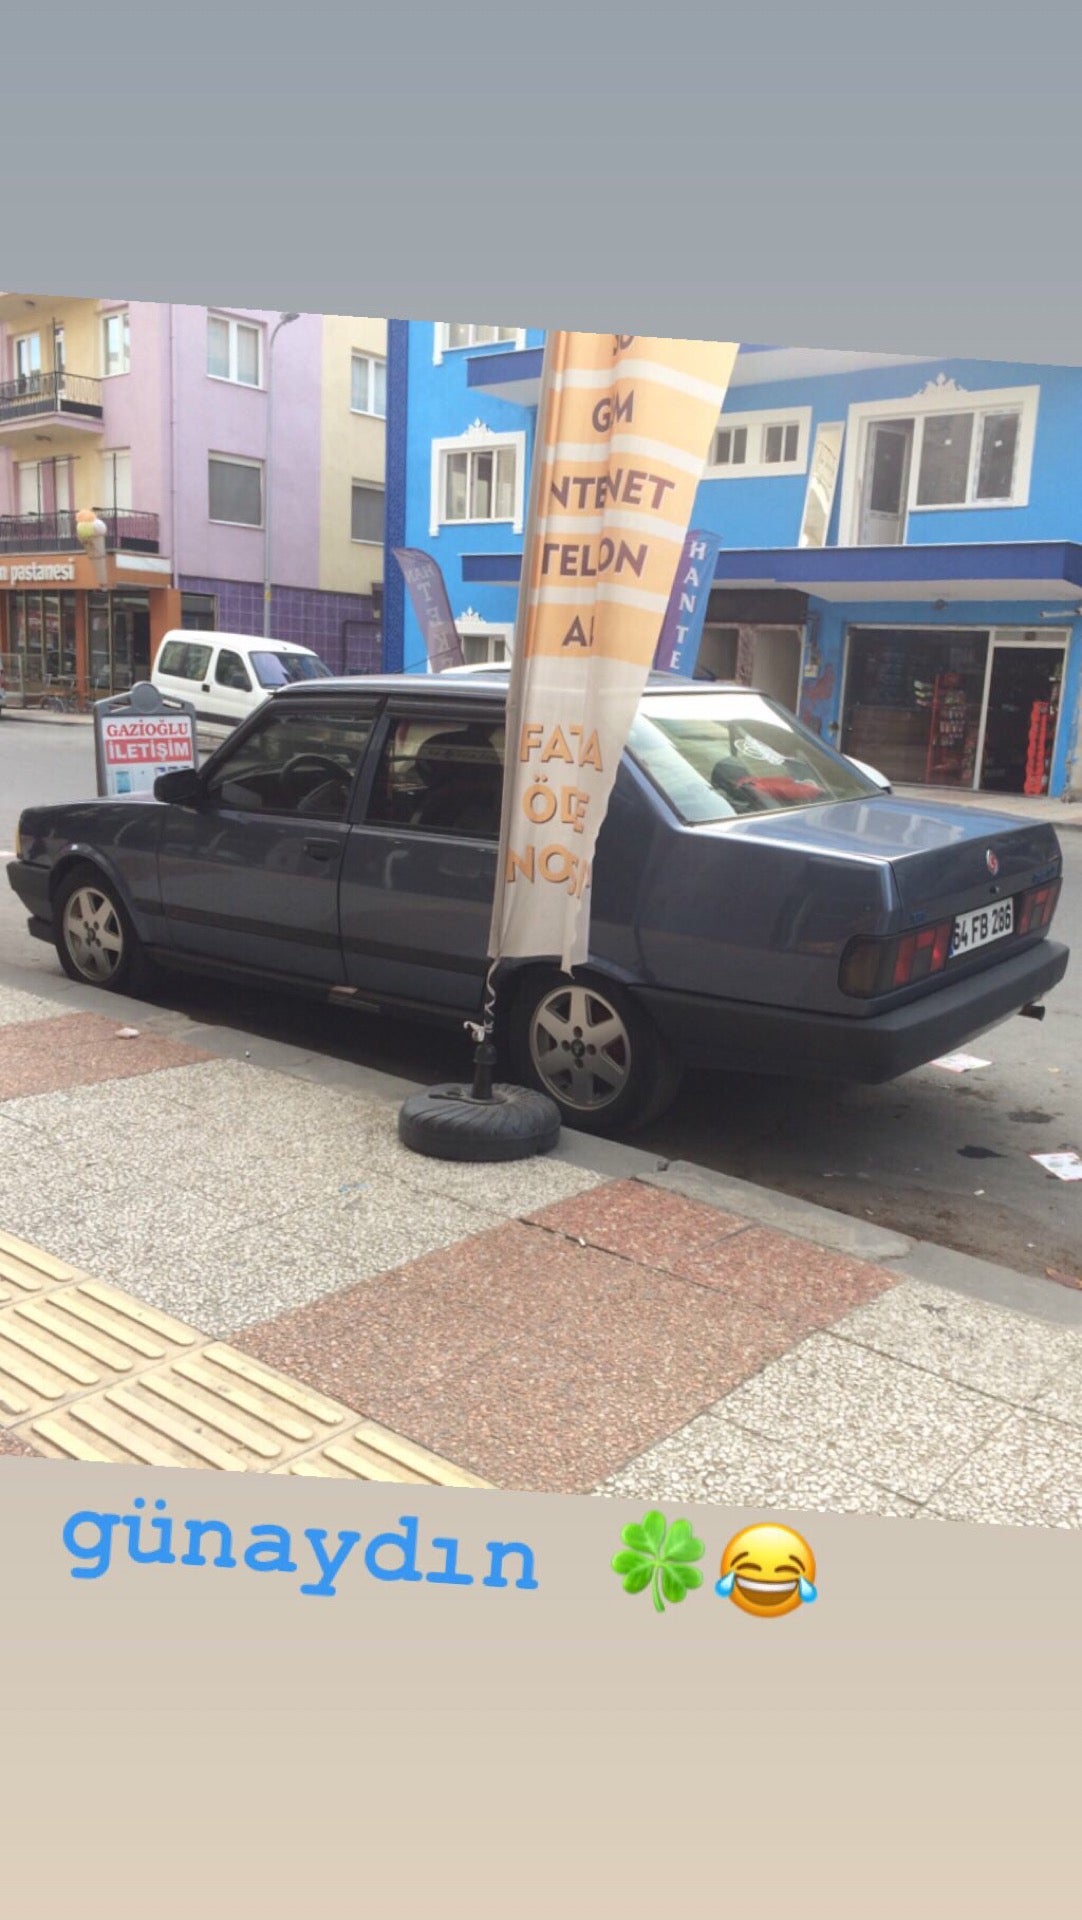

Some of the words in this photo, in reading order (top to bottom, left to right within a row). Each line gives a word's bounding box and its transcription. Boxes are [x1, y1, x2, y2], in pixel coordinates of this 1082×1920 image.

[10, 557, 75, 586] pastanesi
[108, 740, 188, 762] İLETİŞİM
[971, 913, 988, 943] FB
[991, 903, 1012, 935] 286
